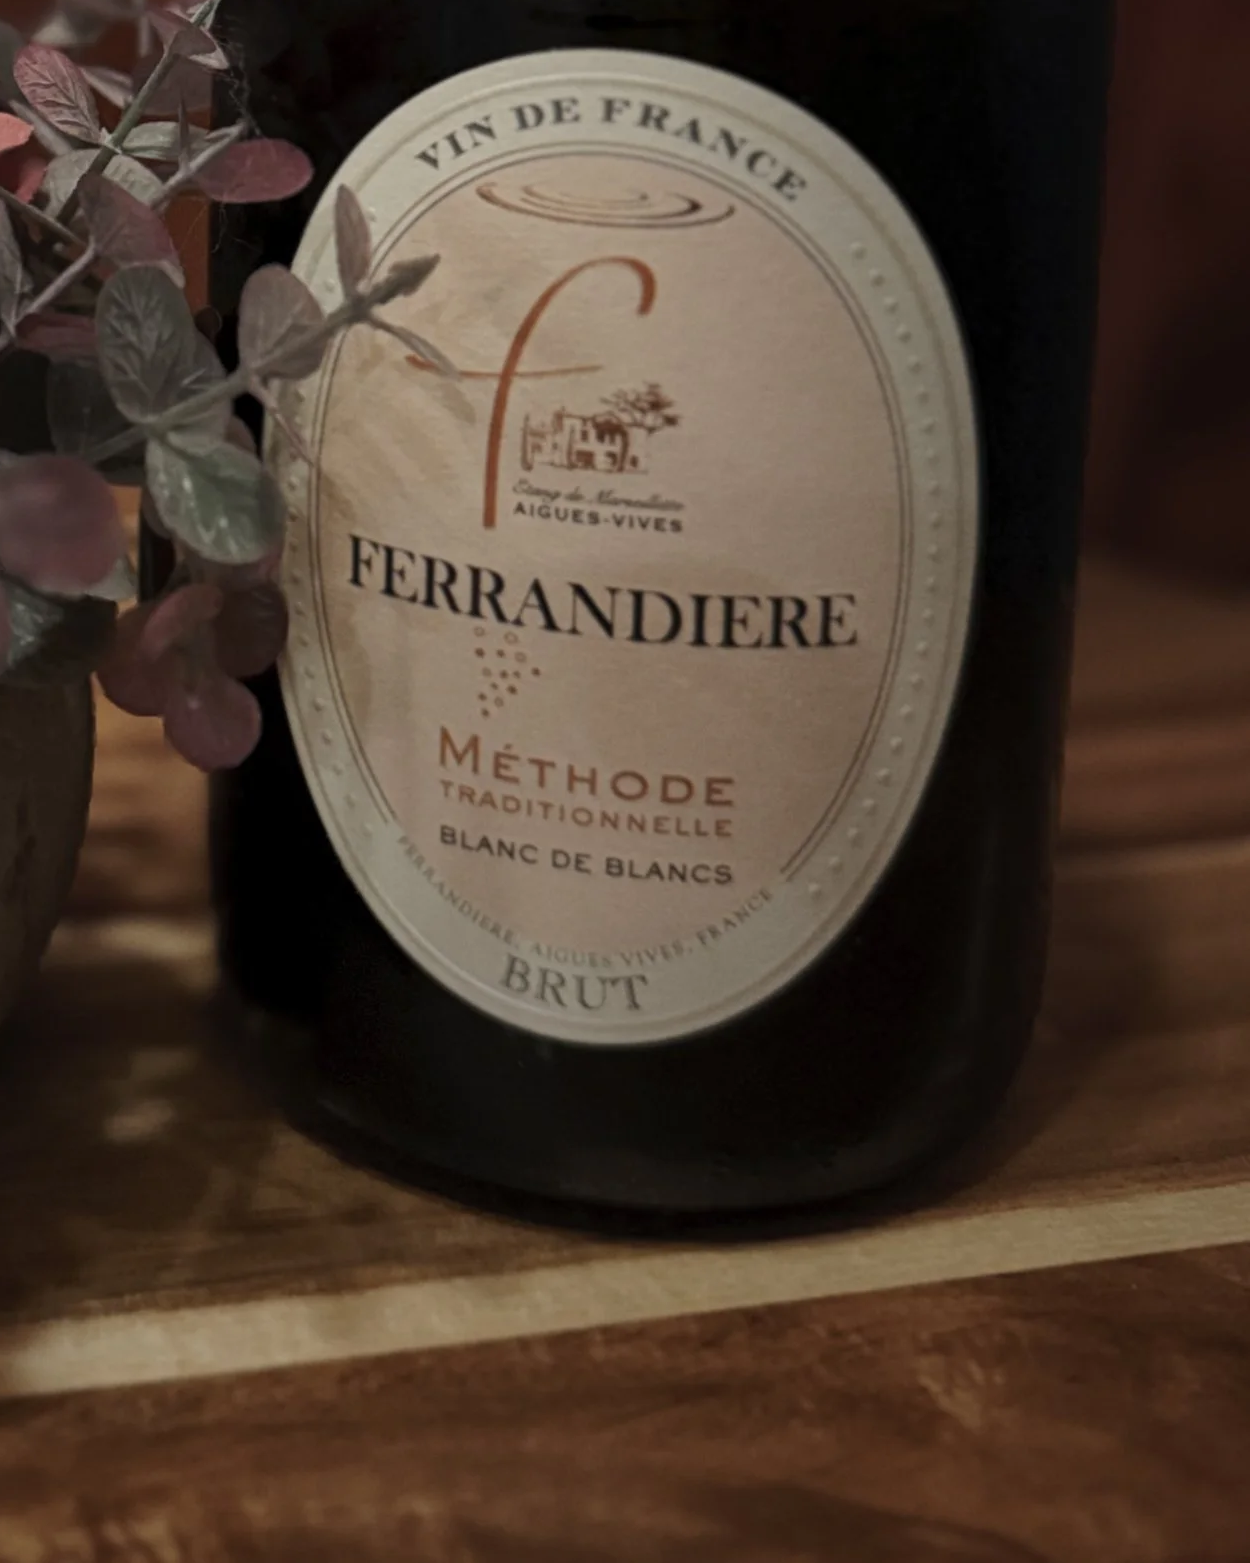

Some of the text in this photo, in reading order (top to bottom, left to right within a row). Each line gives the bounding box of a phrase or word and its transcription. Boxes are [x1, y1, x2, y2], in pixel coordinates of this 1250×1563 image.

[415, 96, 808, 202] VIN DE FRANCE
[513, 501, 683, 533] AIGUES-VIVES
[347, 533, 858, 649] FERRANDIERE
[439, 724, 736, 808] MÉTHODE
[439, 779, 733, 839] TRADITIONNELLE
[439, 824, 734, 886] BLANC DE BLANCS
[695, 887, 774, 946] FRANCE
[500, 953, 648, 1011] BRUT
